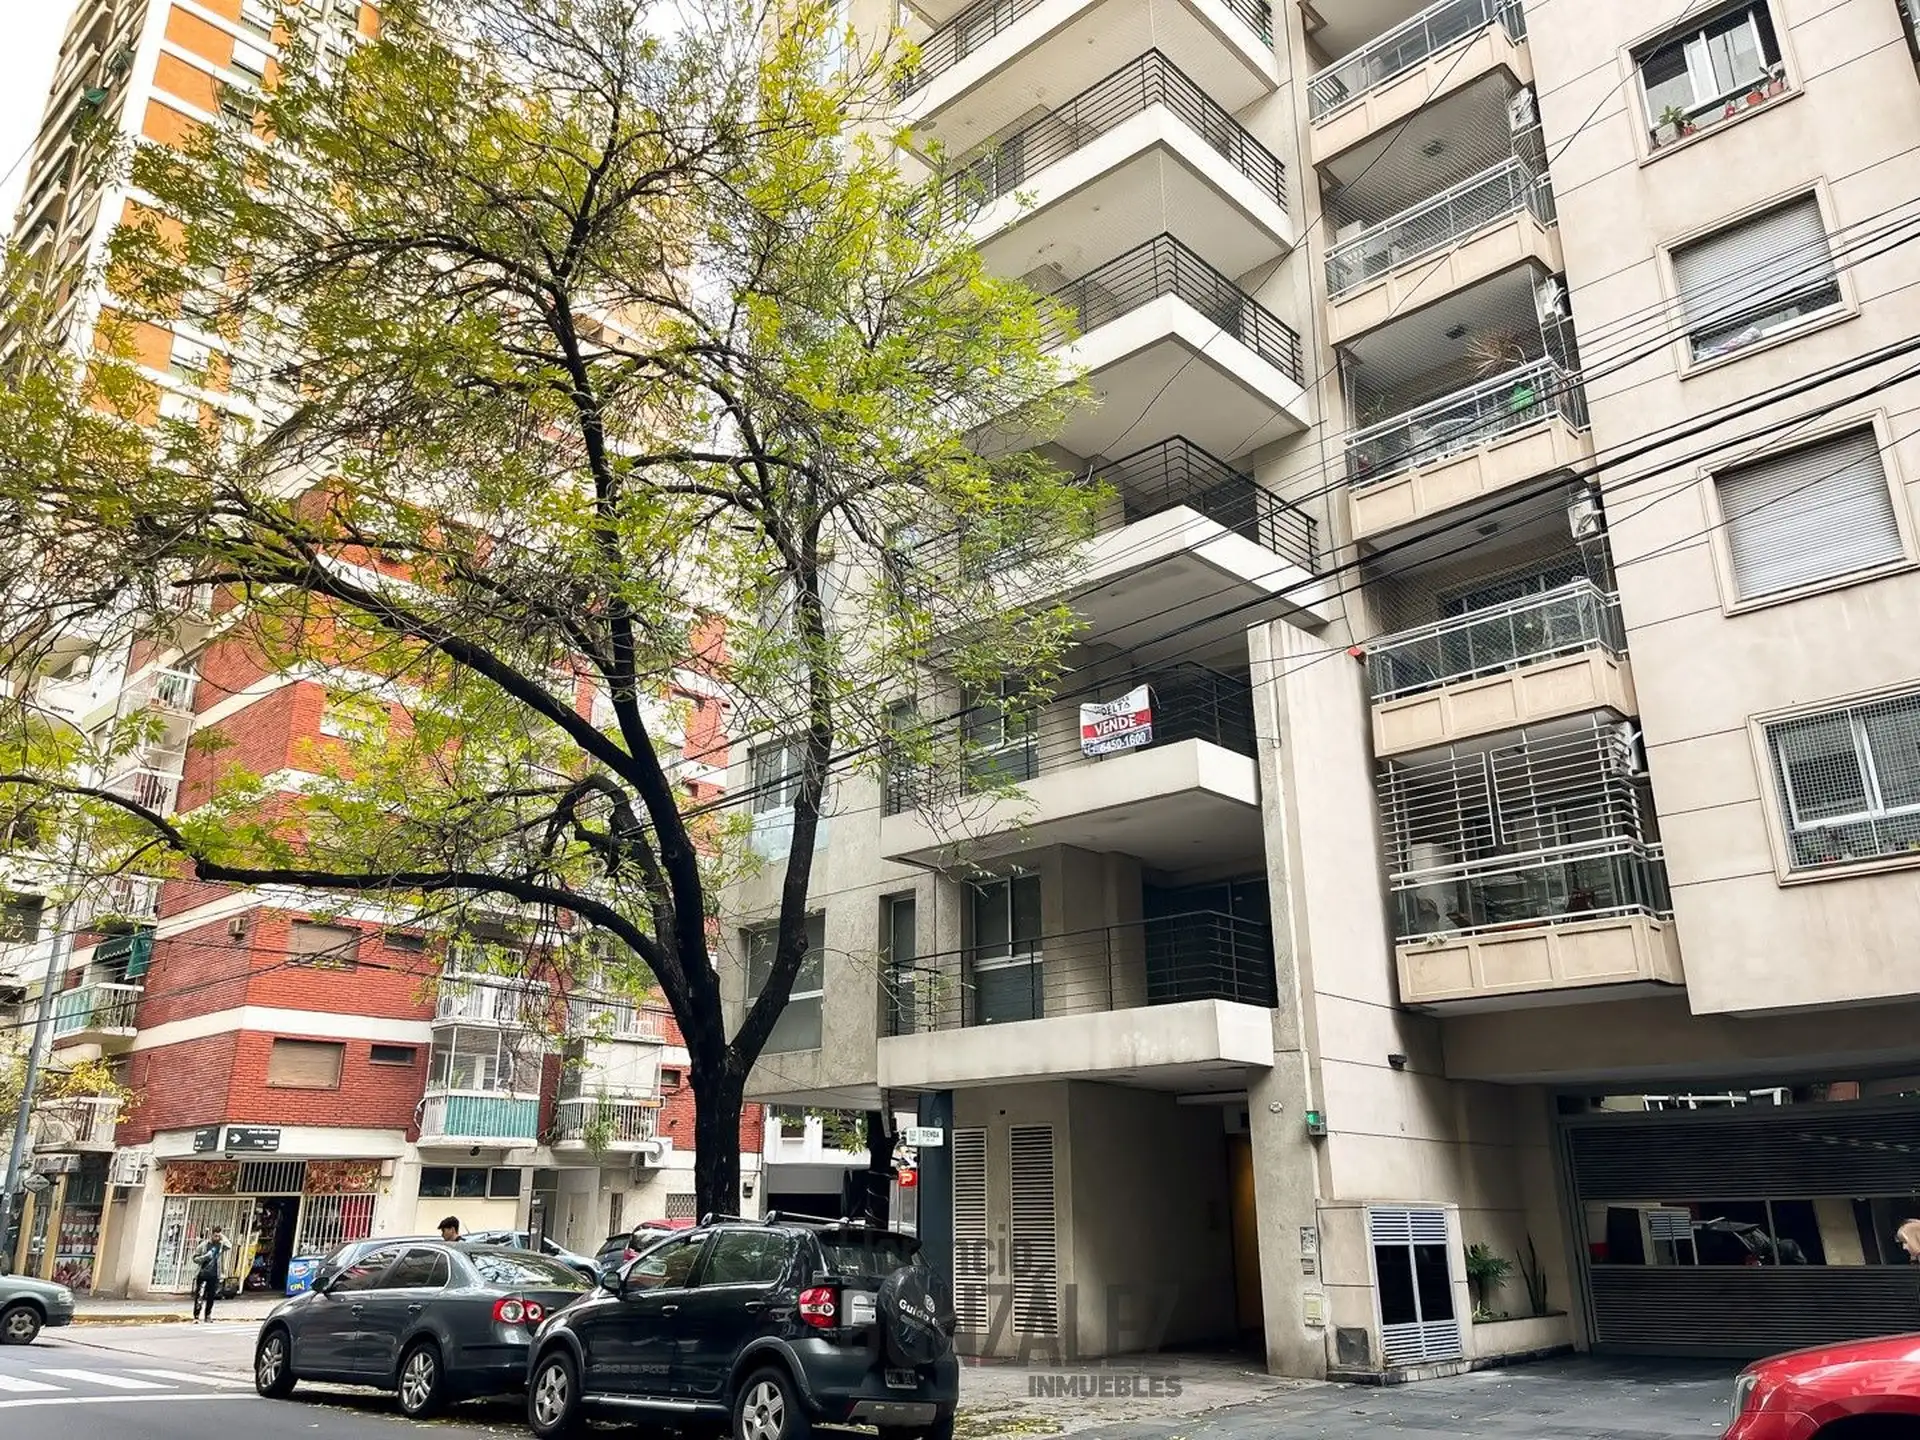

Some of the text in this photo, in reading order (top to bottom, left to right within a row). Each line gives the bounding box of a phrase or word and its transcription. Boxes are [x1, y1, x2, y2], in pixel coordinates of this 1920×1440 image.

[1100, 702, 1132, 715] DELTA
[1094, 713, 1137, 736] VENDE
[899, 1299, 930, 1321] Guido
